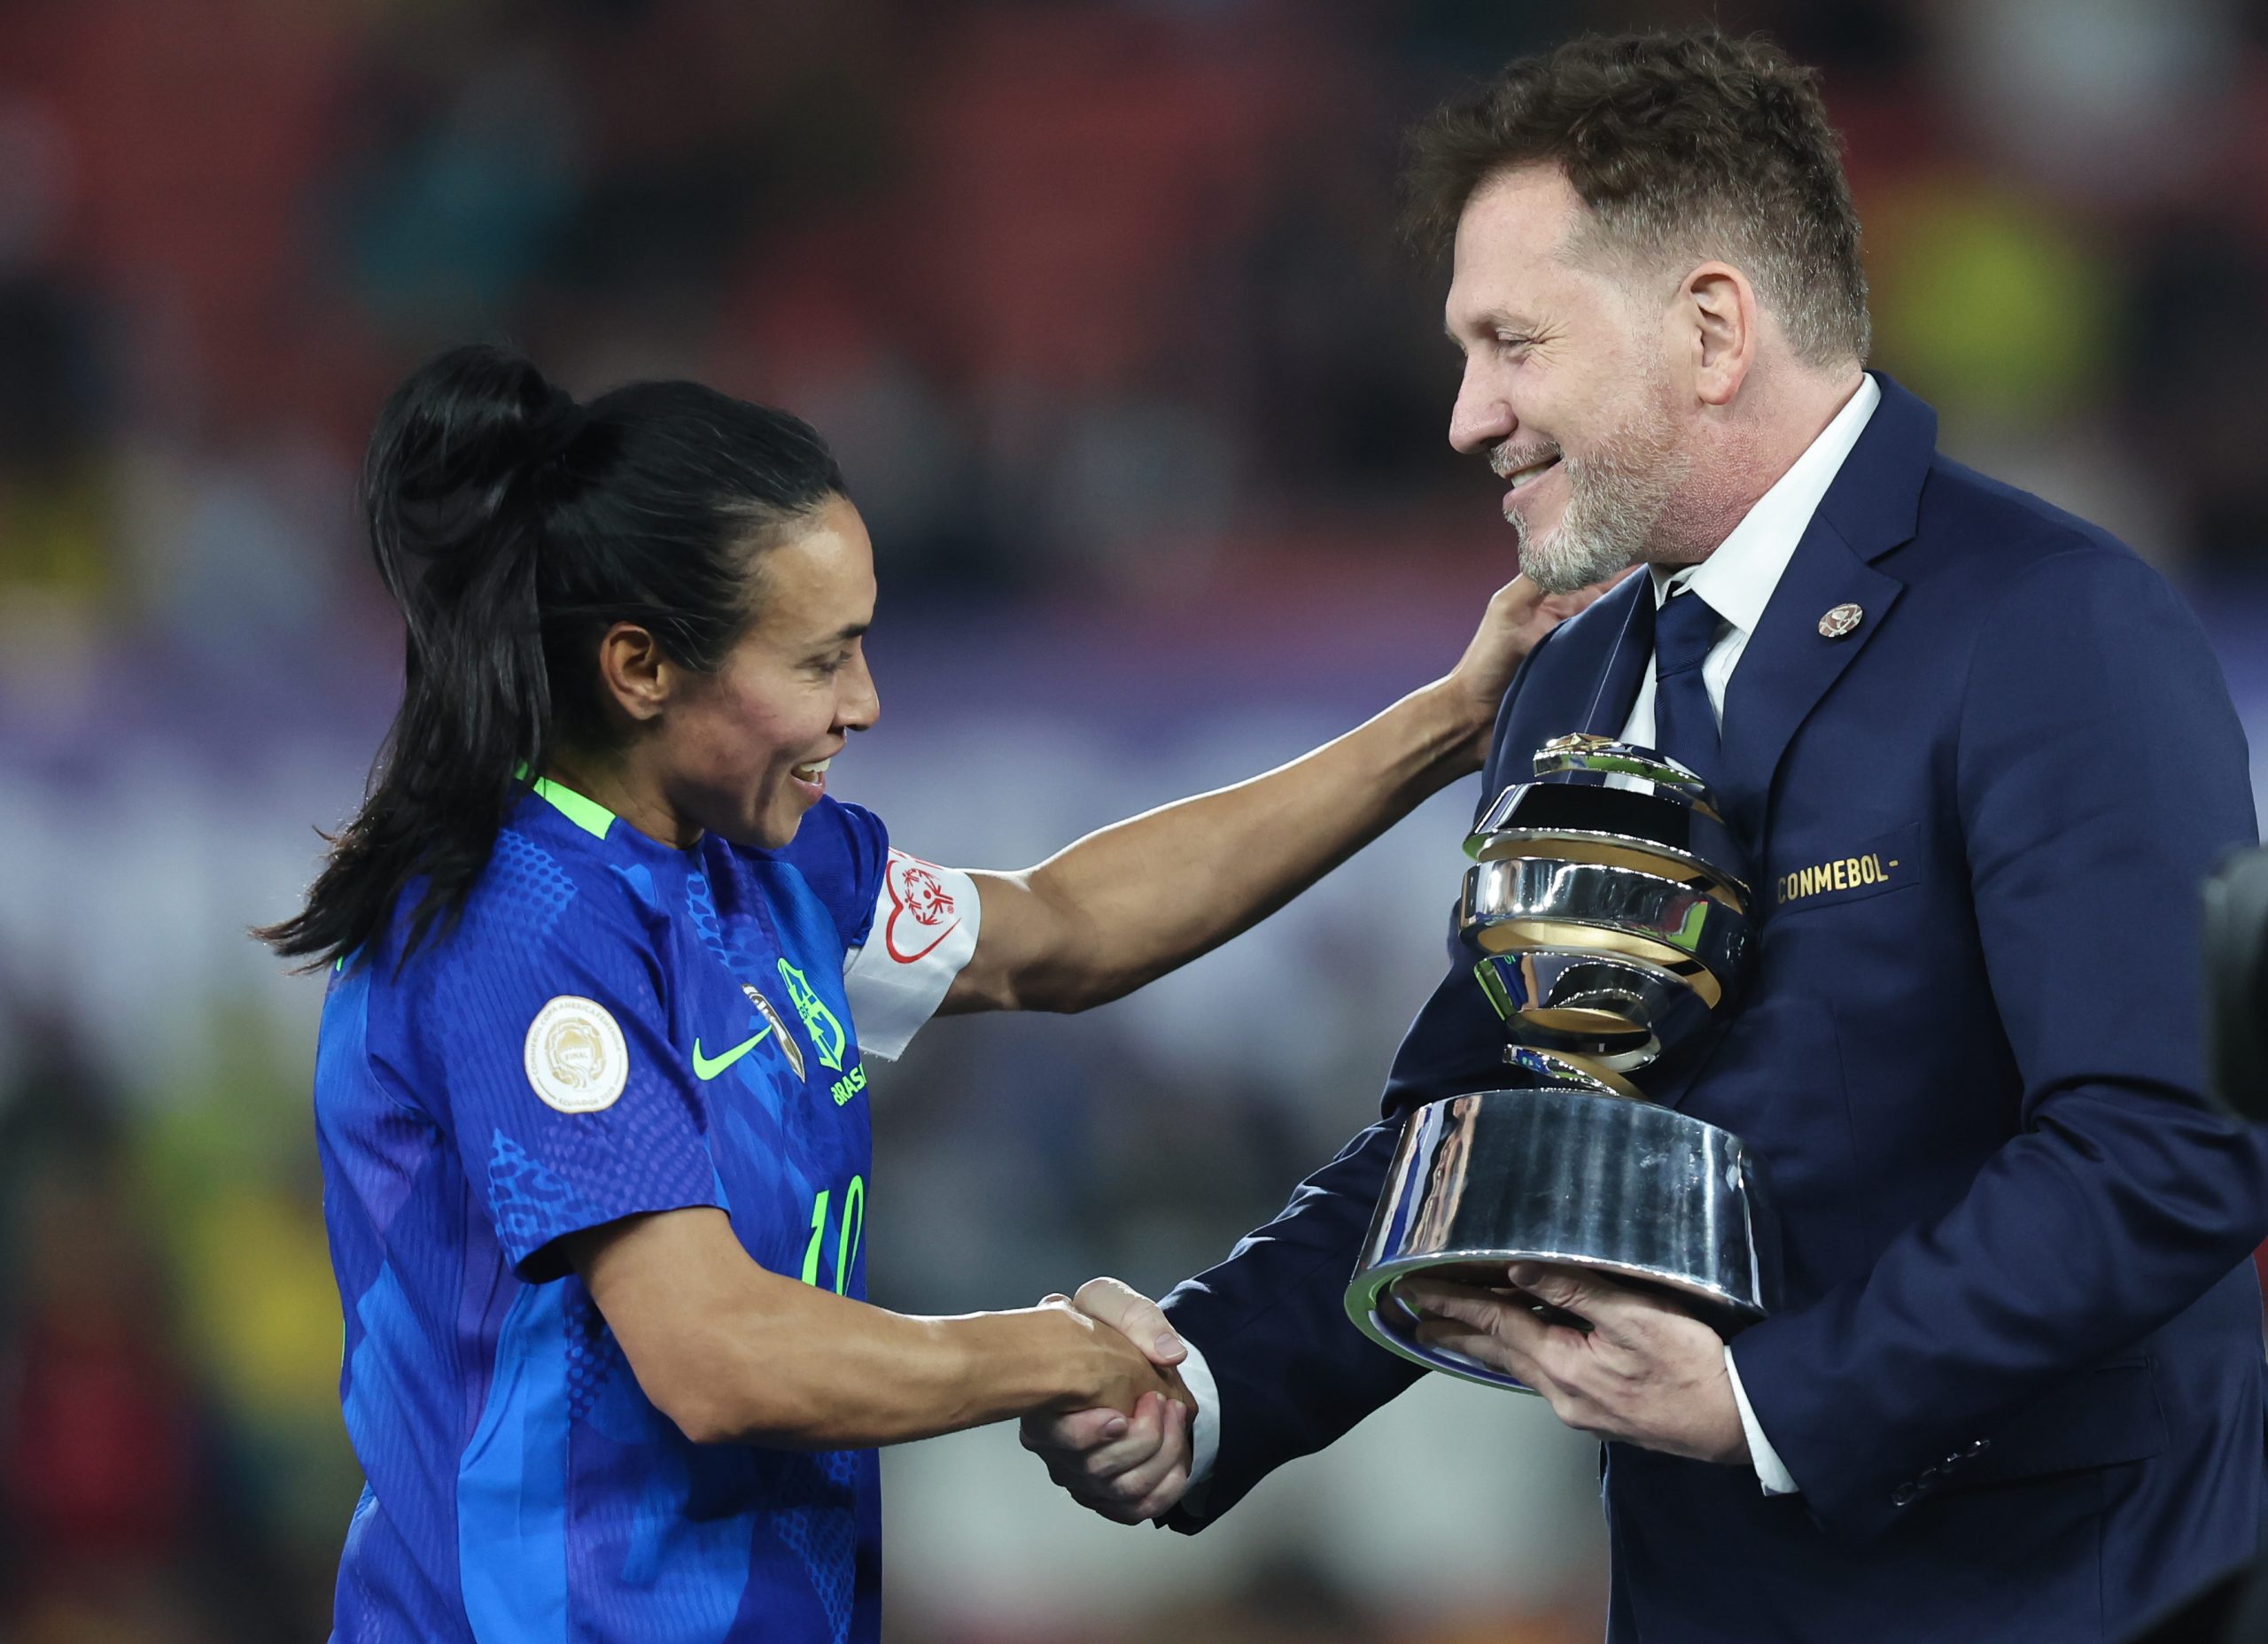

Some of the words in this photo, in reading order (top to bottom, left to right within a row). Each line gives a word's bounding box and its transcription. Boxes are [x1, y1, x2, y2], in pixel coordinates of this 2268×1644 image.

[565, 1051, 588, 1061] FINAL
[558, 1097, 599, 1107] ECUADOR
[802, 1175, 864, 1297] 10
